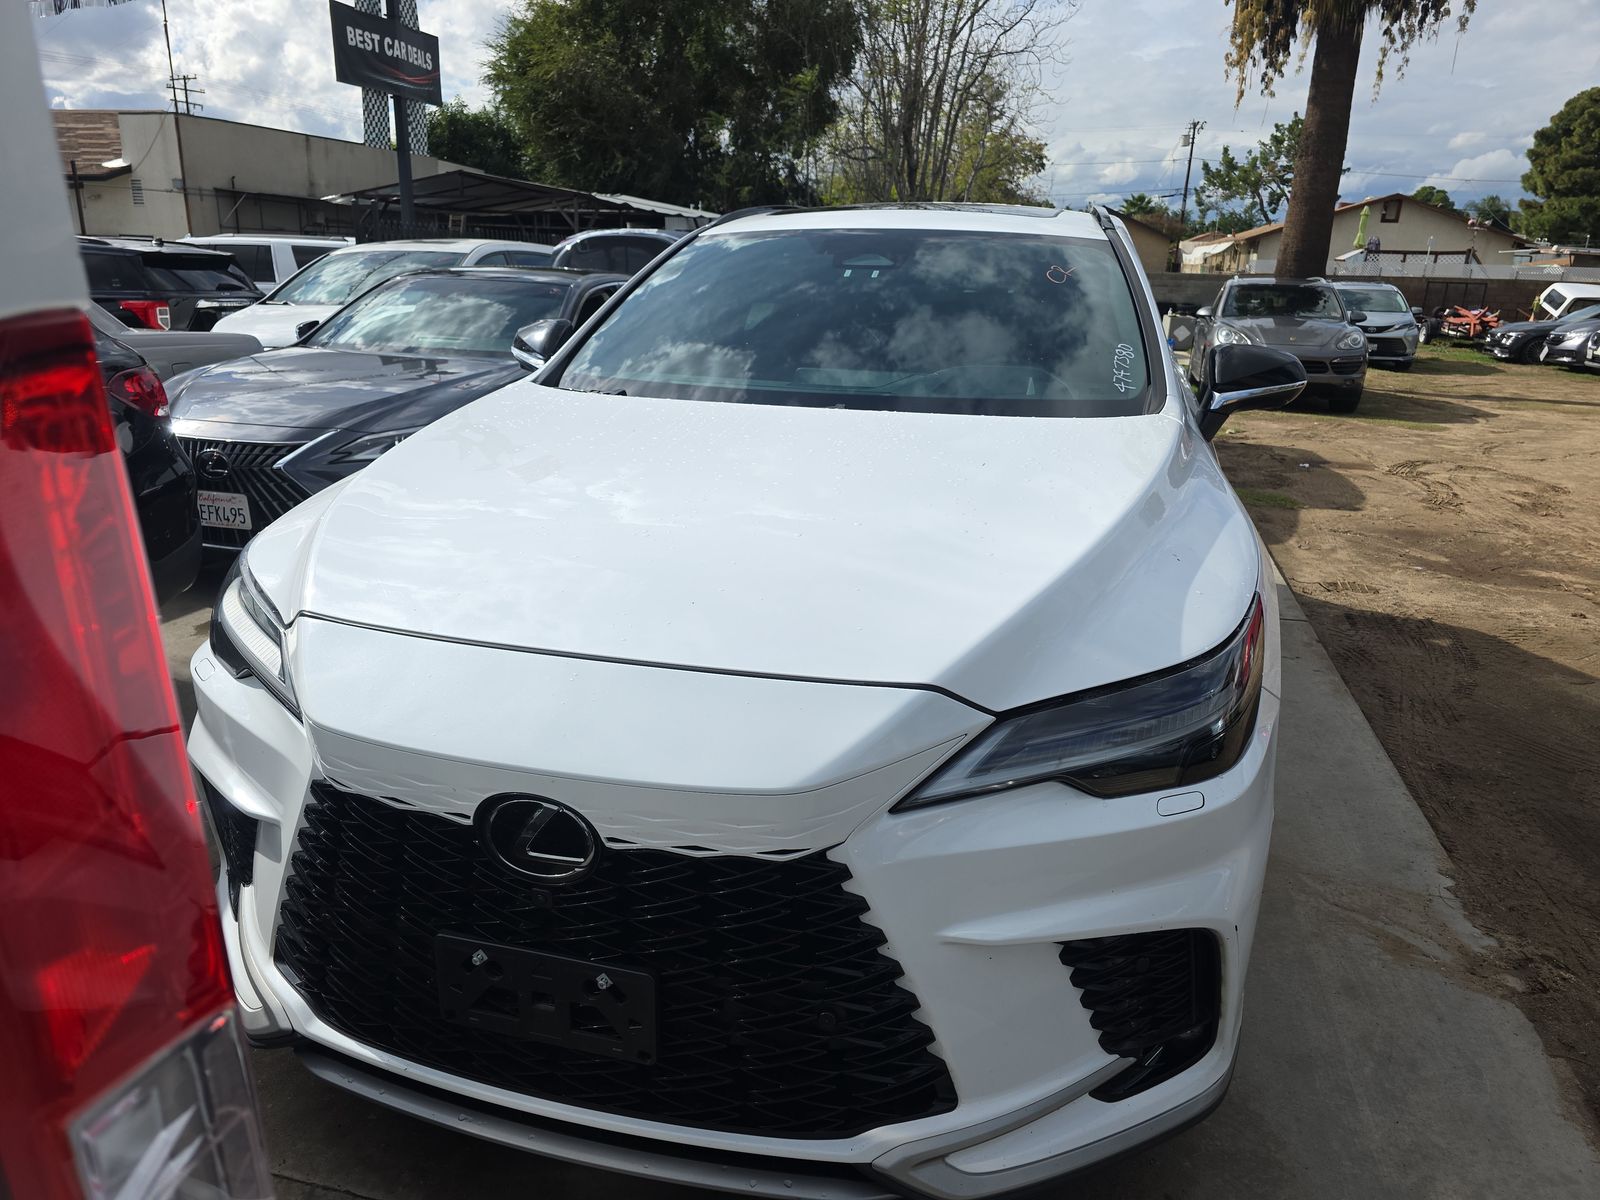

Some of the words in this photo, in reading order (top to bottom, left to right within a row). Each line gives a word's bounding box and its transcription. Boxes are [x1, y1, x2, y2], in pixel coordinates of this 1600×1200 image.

[346, 26, 381, 53] BEST
[384, 37, 407, 61] CAR
[408, 44, 433, 71] DEALS
